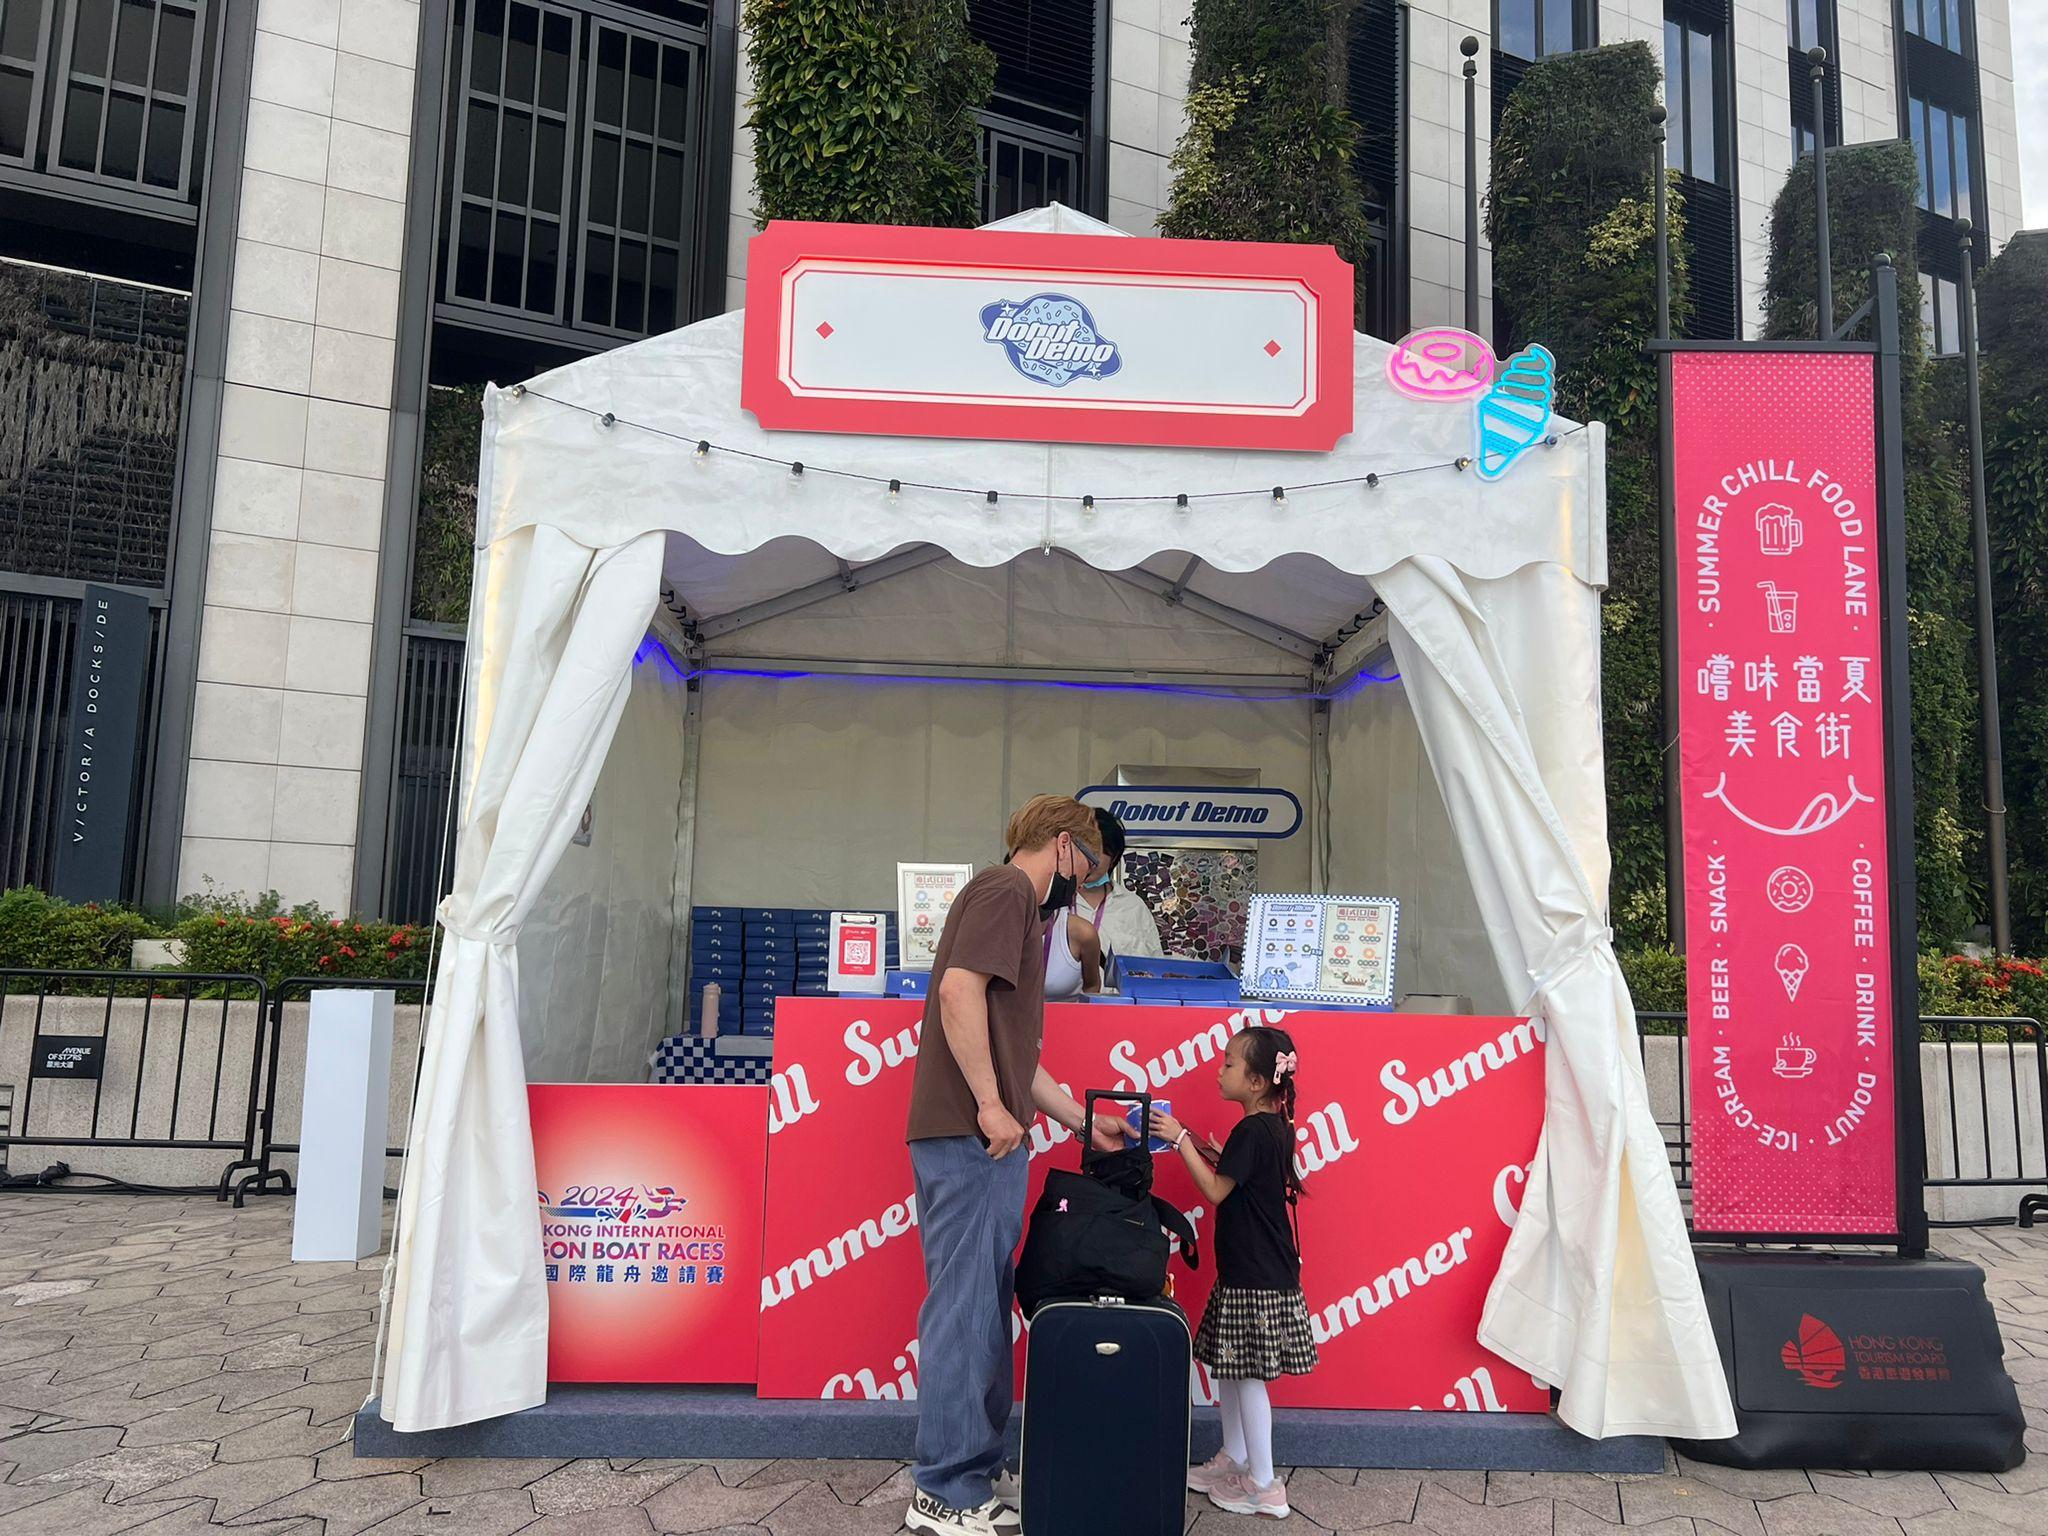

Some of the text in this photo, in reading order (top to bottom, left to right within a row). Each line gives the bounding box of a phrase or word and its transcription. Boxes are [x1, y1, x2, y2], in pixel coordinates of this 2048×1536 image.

[986, 316, 1081, 343] Donut
[1024, 336, 1115, 363] Demo
[1696, 459, 1867, 617] SUMMER CHILL FOOD LANE
[1697, 652, 1872, 704] 嚐味當夏
[1723, 709, 1851, 760] 美食街
[1109, 799, 1269, 824] Donut Demo
[1707, 854, 1877, 1152] COFFEE DRINK DONUT ICE-CREAM BEER SNACK
[560, 1185, 640, 1208] 2024
[543, 1224, 725, 1239] KONG INTERNATIONAL
[592, 1241, 651, 1261] BOAT
[657, 1242, 725, 1262] RACES
[1849, 1335, 1943, 1351] HONG KONG
